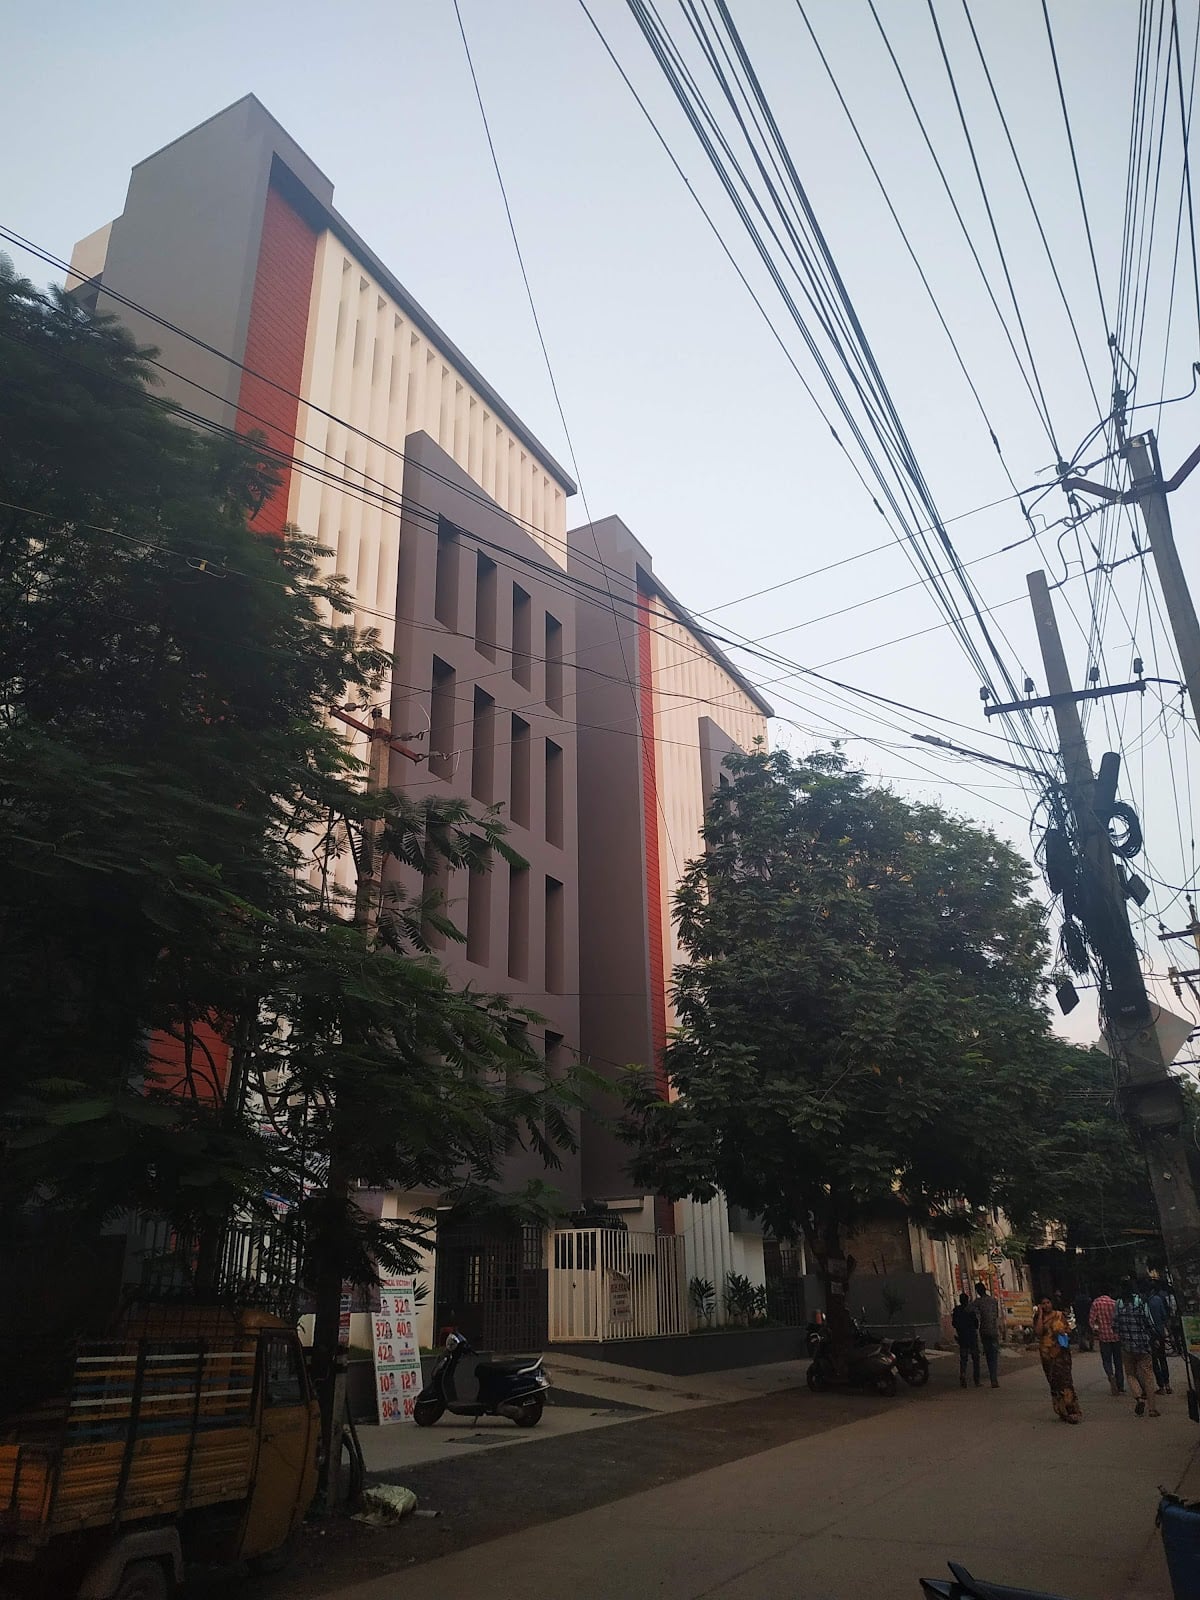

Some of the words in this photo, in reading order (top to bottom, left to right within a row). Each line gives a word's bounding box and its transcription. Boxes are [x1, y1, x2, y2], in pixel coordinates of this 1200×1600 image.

[395, 1299, 405, 1313] 32
[376, 1322, 385, 1337] 37
[397, 1321, 406, 1336] 40
[378, 1345, 388, 1360] 42
[379, 1375, 390, 1392] 10
[401, 1374, 411, 1390] 12
[382, 1400, 392, 1417] 36
